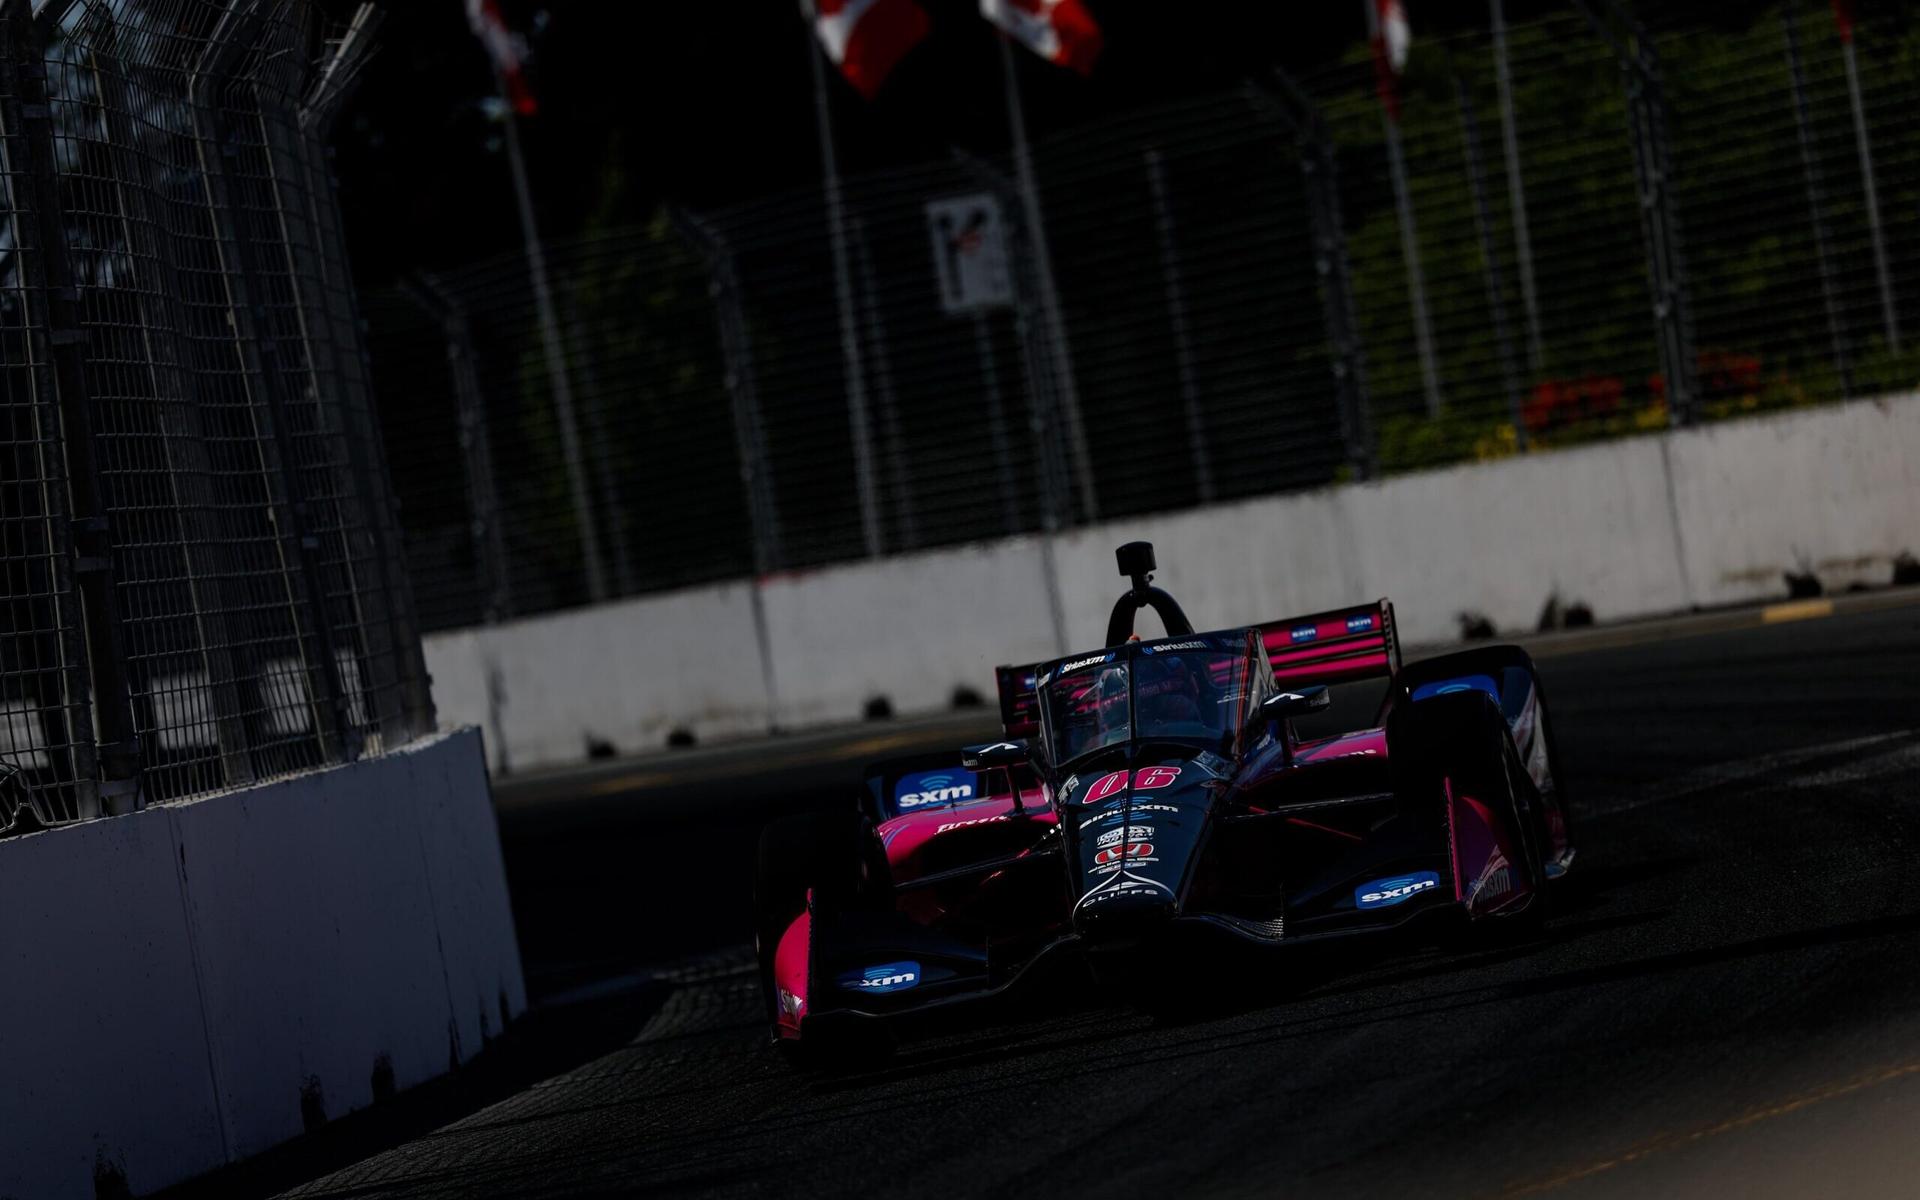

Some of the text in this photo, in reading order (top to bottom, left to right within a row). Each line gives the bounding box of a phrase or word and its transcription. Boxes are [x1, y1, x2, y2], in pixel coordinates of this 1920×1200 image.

[899, 784, 972, 807] sxm
[1083, 766, 1182, 804] 06
[1362, 878, 1434, 902] sxm
